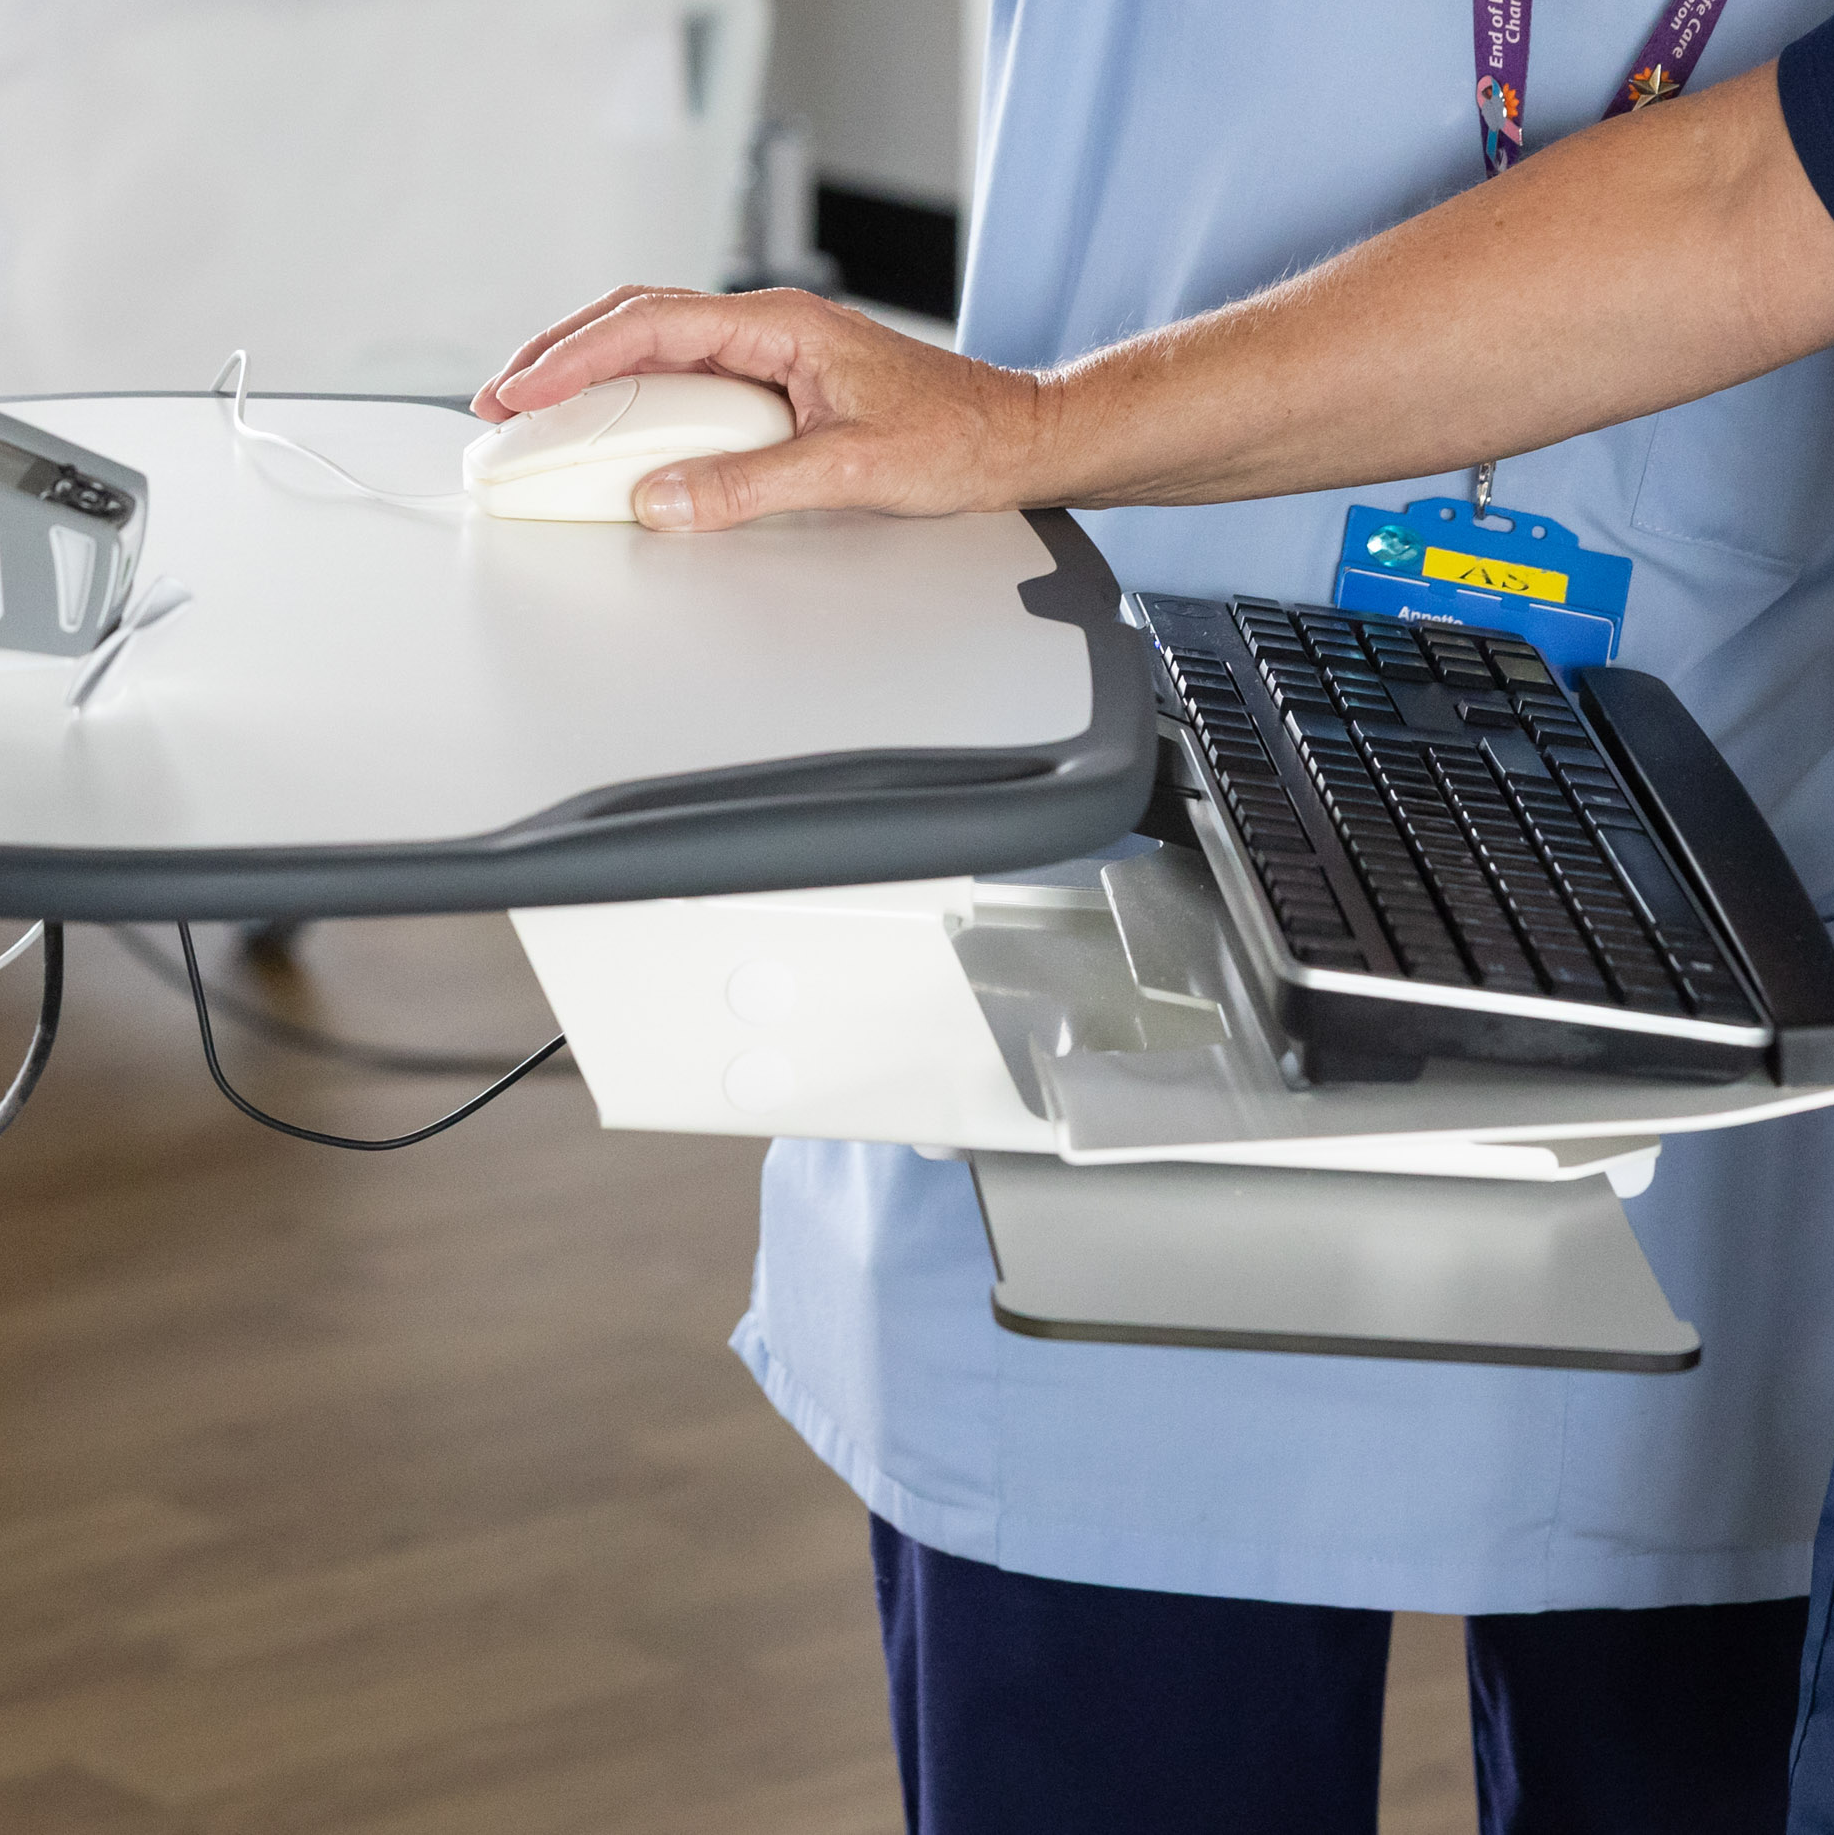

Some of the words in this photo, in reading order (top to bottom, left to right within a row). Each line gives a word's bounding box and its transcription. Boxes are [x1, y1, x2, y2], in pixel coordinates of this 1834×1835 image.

[1488, 5, 1503, 28] of
[1488, 32, 1503, 68] End
[1671, 18, 1701, 59] Care
